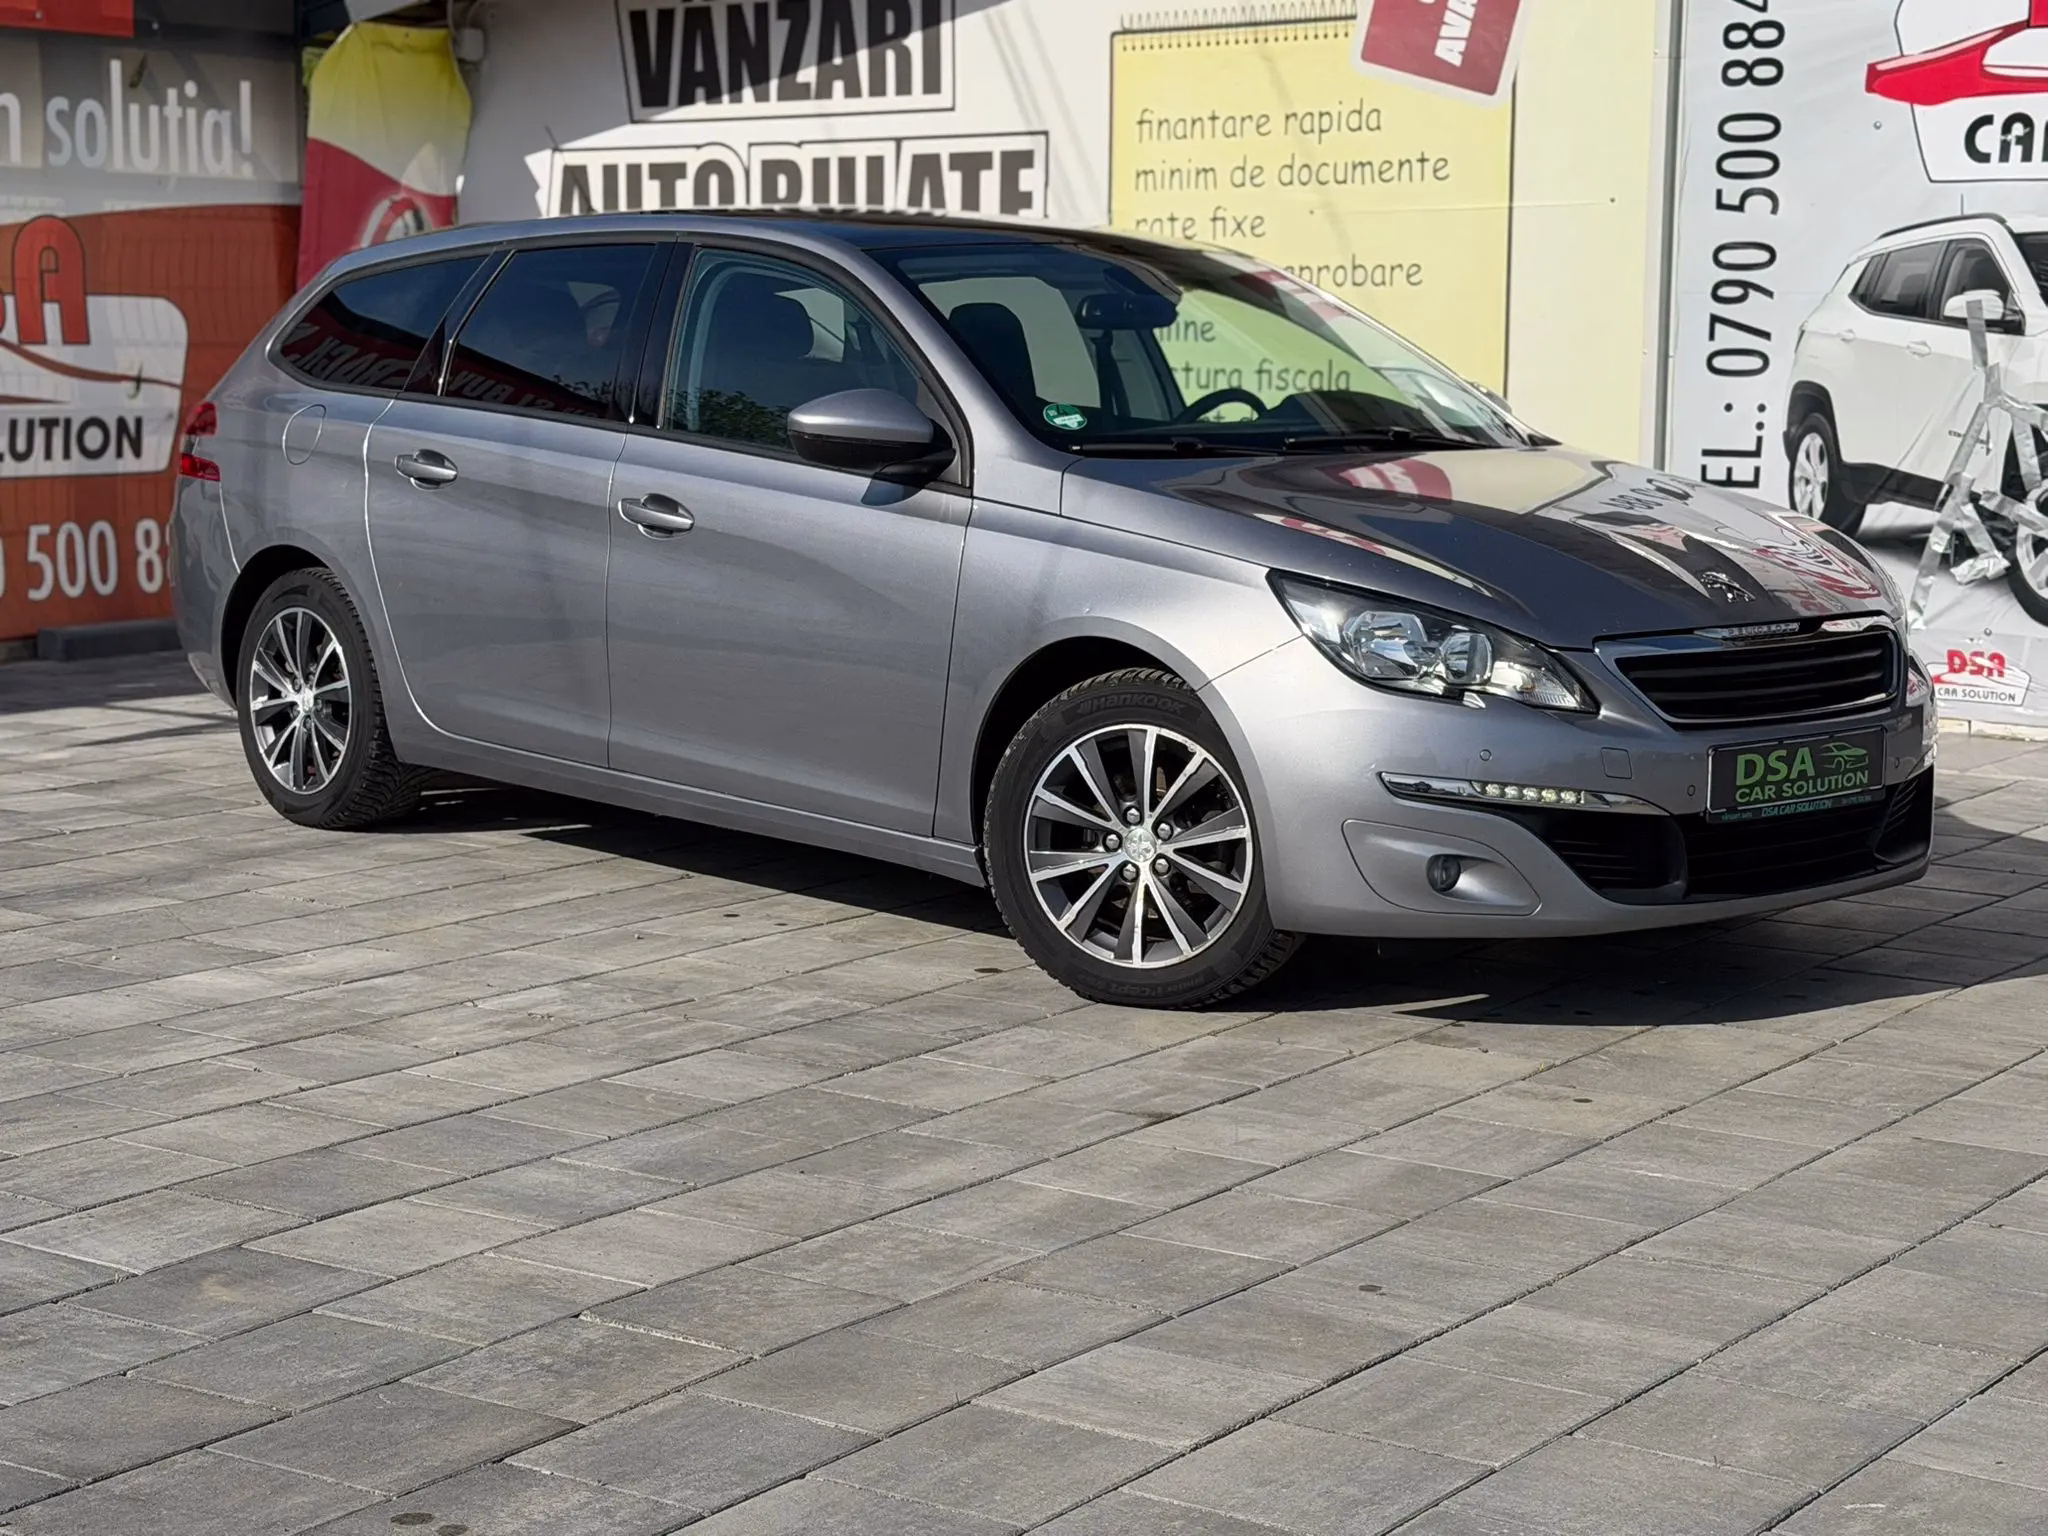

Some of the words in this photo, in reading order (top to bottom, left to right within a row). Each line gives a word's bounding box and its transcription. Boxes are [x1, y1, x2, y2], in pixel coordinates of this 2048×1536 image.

[1136, 107, 1272, 143] finantare
[1284, 97, 1382, 145] rapida
[1964, 112, 2048, 163] CA
[1135, 158, 1217, 192] minim
[1230, 154, 1266, 188] de
[1278, 151, 1450, 187] documente
[1715, 113, 1782, 216] 500
[1209, 205, 1266, 241] fixe
[1706, 241, 1777, 377] 0790
[1170, 360, 1242, 389] tura
[1254, 358, 1350, 391] fiscala
[0, 415, 143, 462] UTION
[27, 520, 118, 601] 500
[1937, 687, 1958, 697] CAR
[1961, 689, 2016, 702] SOLUTION
[1735, 784, 1776, 803] CAR
[1781, 770, 1869, 800] SOLUTION
[1736, 747, 1816, 786] DSA
